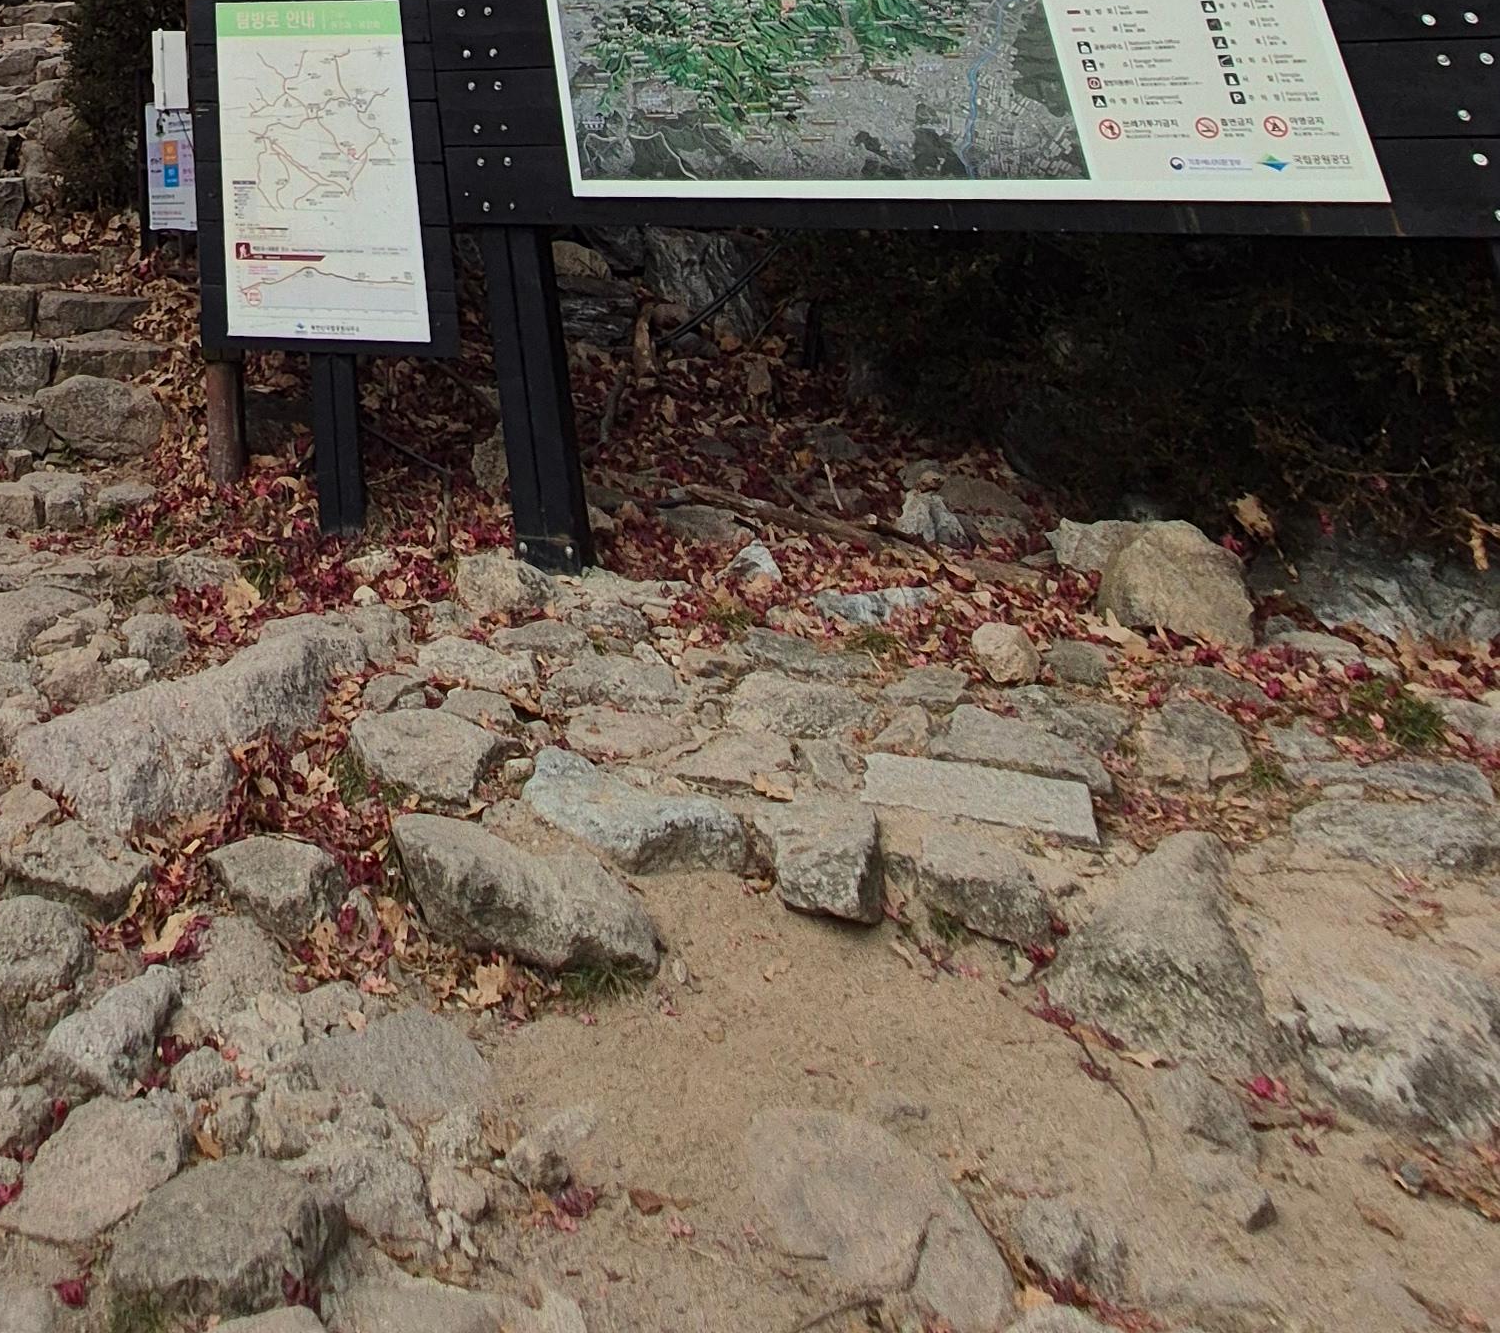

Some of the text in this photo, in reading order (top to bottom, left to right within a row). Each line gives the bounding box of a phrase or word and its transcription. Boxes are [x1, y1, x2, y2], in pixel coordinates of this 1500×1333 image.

[235, 10, 281, 30] 탐방로
[286, 10, 315, 29] 안내
[1292, 154, 1351, 165] 국립공원공단
